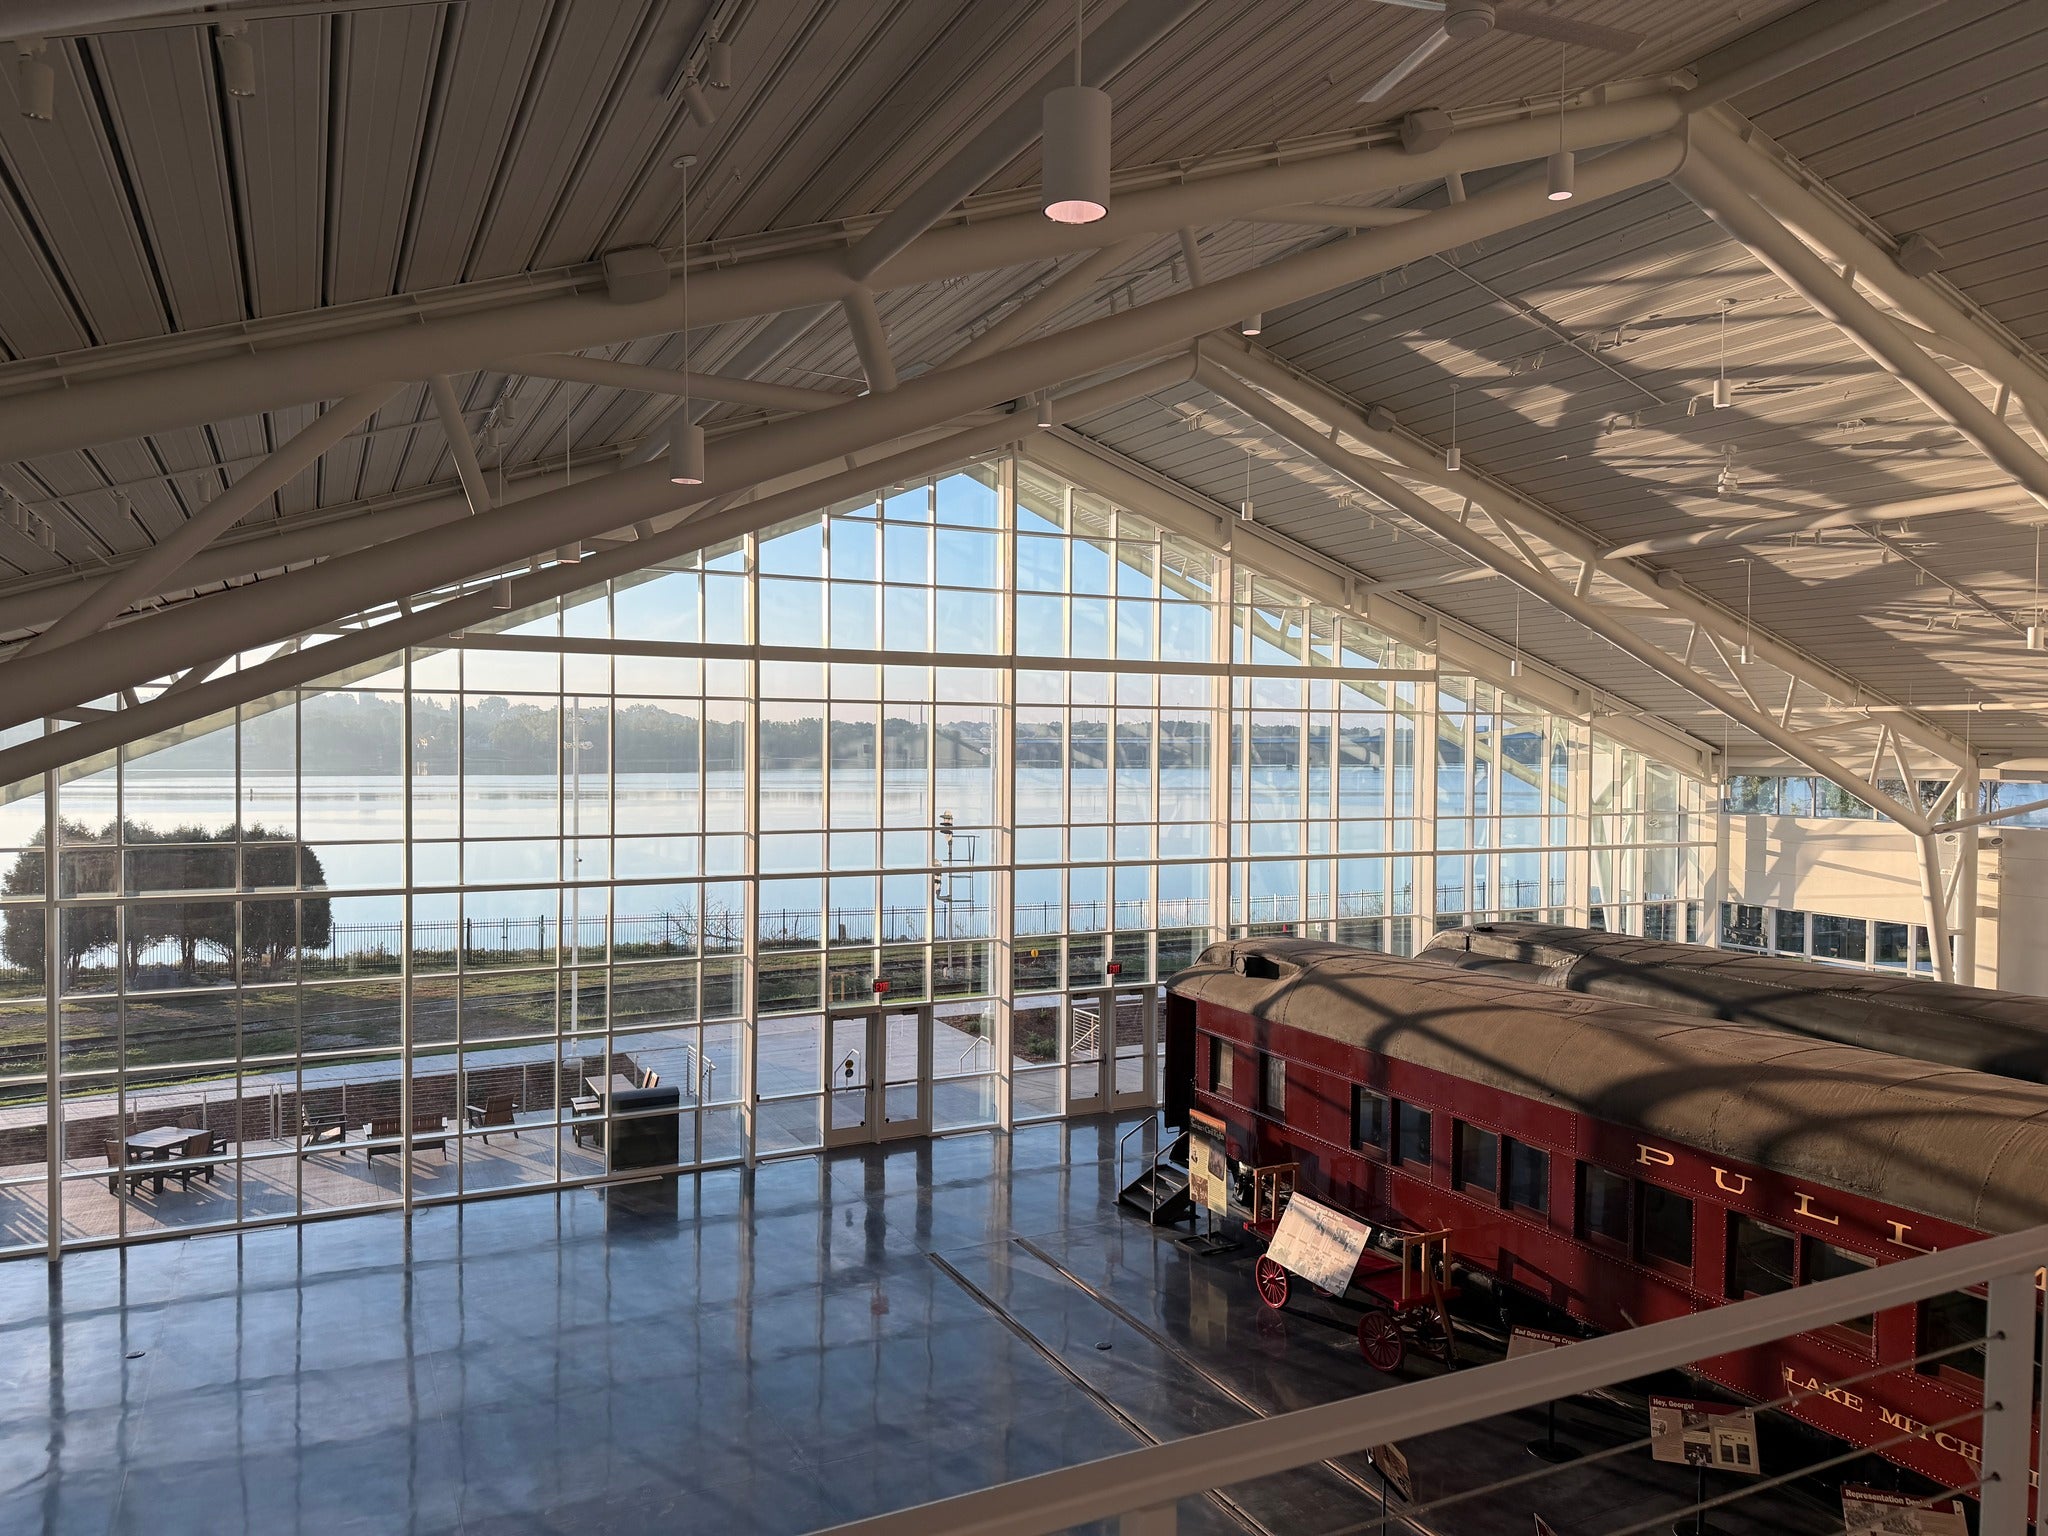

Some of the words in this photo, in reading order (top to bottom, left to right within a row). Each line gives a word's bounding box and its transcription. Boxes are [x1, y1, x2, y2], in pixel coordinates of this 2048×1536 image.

[1514, 1327, 1526, 1336] Bad
[1526, 1330, 1541, 1340] Days
[1541, 1333, 1551, 1341] for
[1550, 1335, 1561, 1343] Jim
[1785, 1366, 1863, 1413] LAKE
[1652, 1397, 1668, 1408] Hey,
[1668, 1400, 1695, 1410] George!
[1845, 1488, 1904, 1505] Representation
